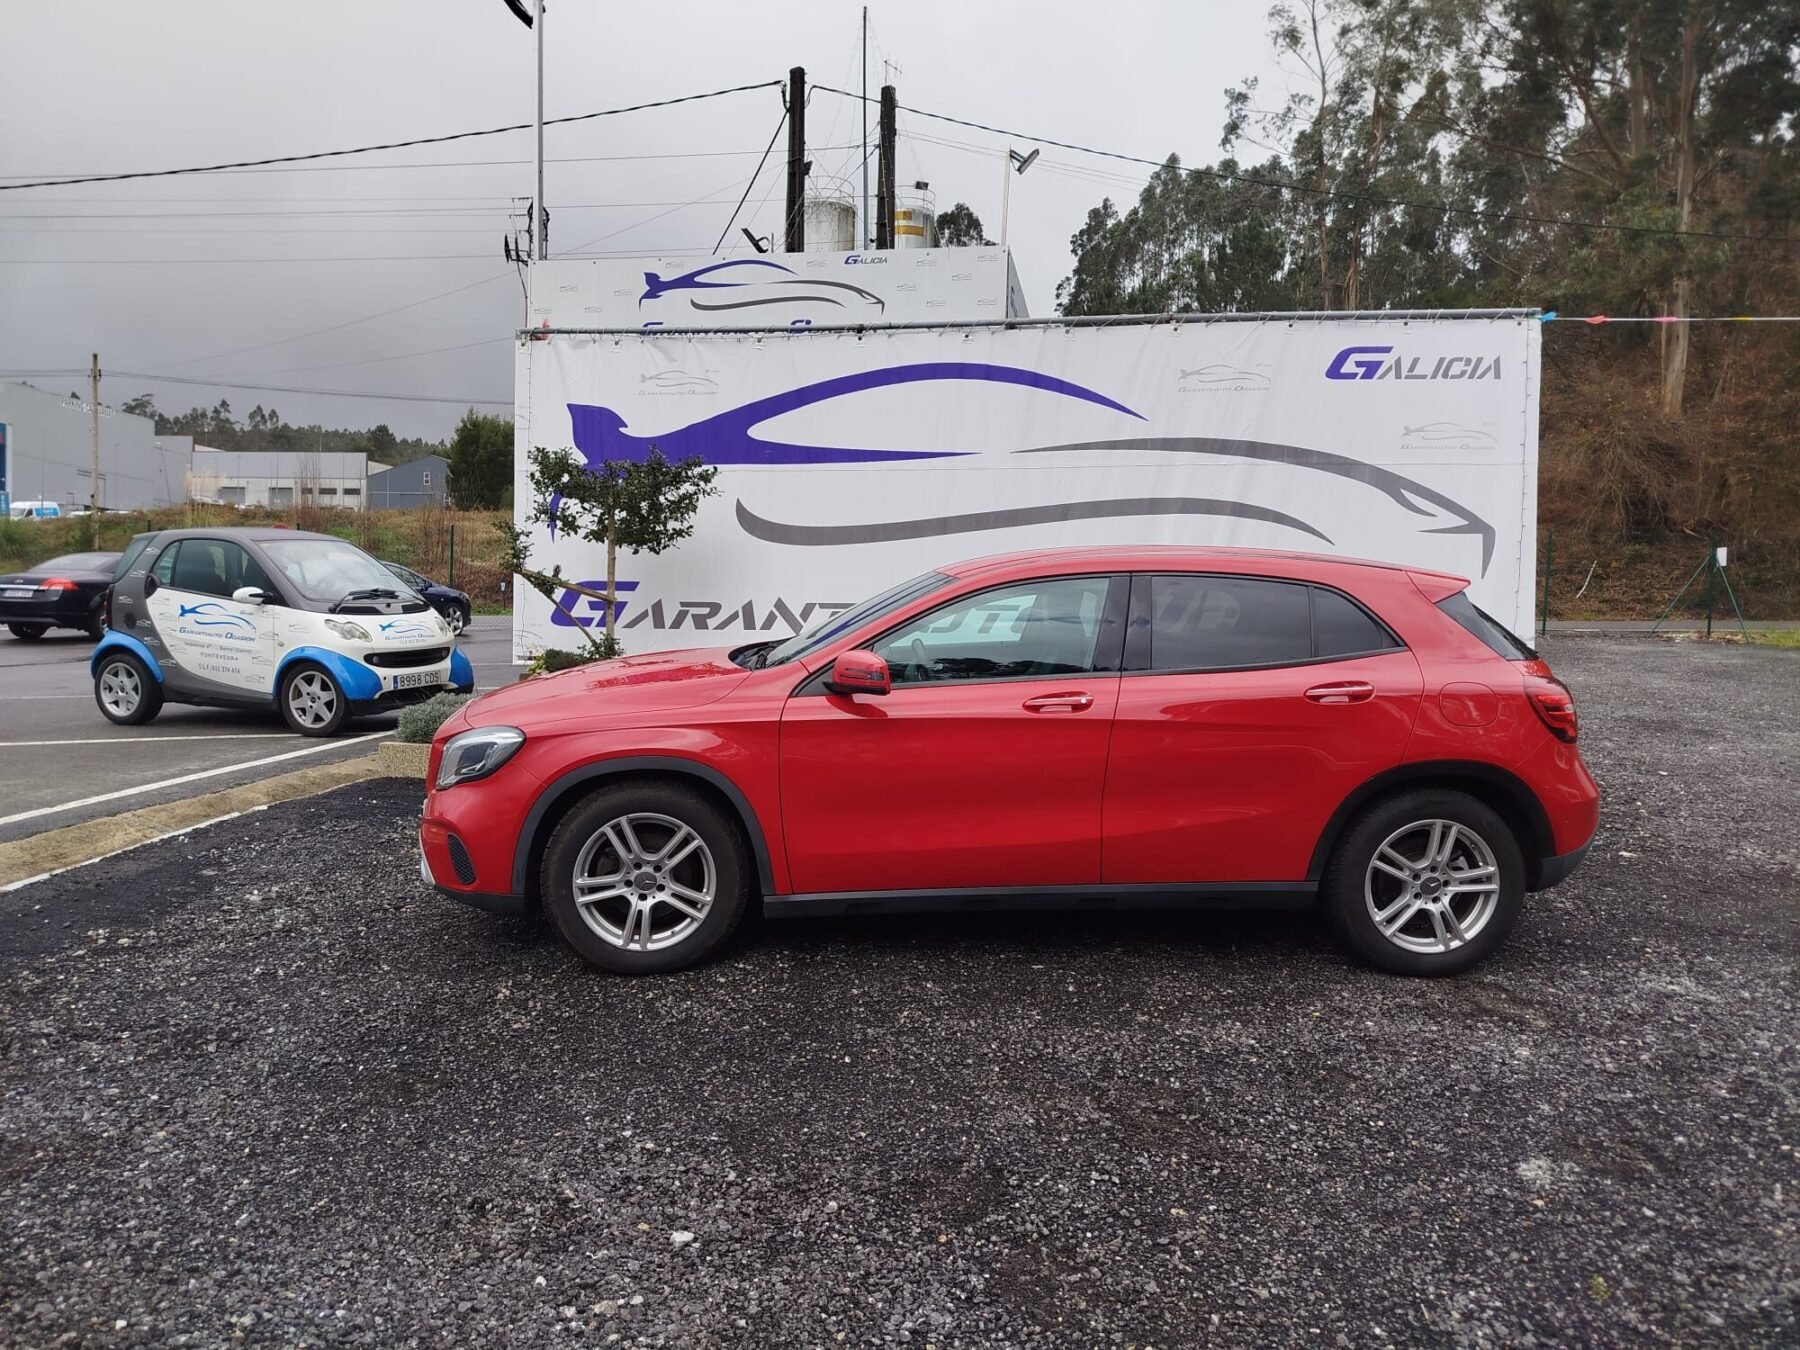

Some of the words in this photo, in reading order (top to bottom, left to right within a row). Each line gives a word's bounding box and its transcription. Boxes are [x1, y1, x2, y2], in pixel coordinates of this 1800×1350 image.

[844, 254, 888, 265] GALICIA
[1325, 346, 1502, 380] GALICIA
[399, 674, 422, 687] 8998
[424, 671, 439, 684] CDS
